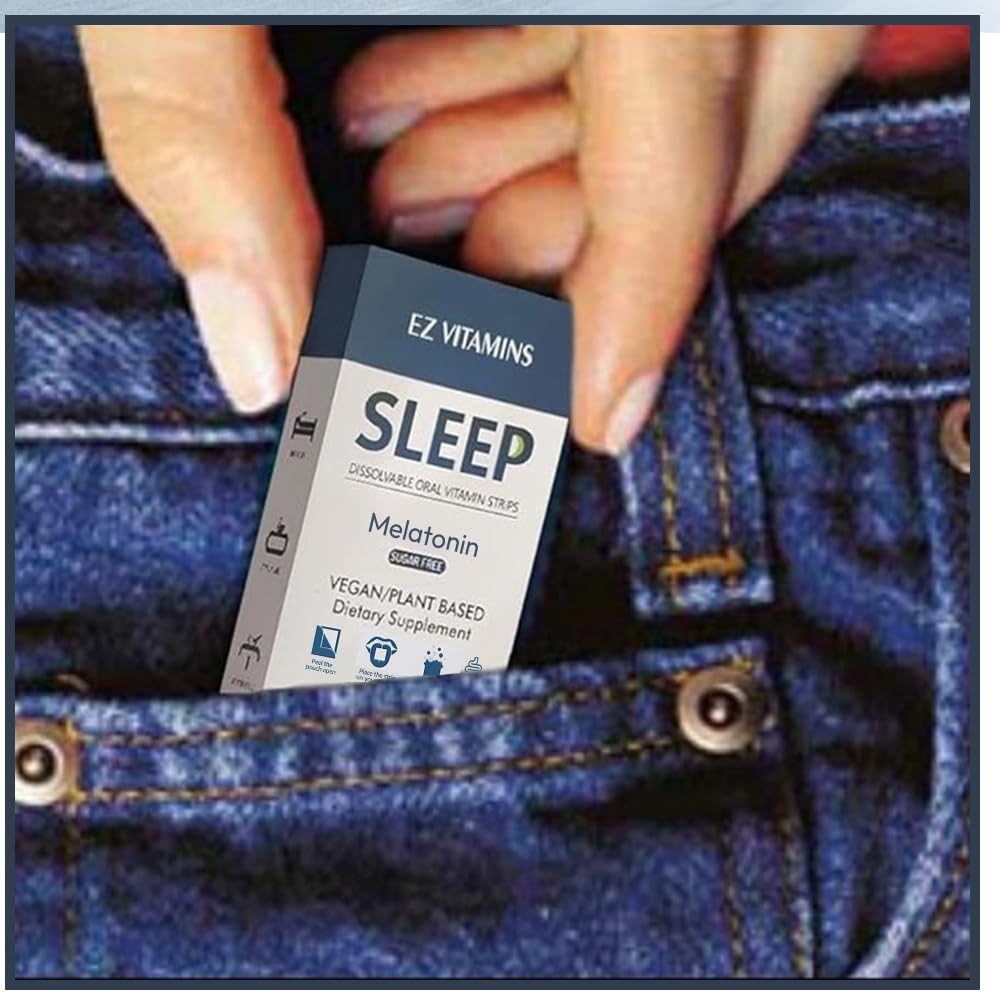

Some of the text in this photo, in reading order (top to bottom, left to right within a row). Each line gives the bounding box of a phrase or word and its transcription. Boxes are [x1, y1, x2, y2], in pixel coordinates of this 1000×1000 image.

[408, 312, 534, 367] EZ VITAMINS
[355, 391, 535, 482] SLEEP
[349, 463, 519, 514] DISSOLVABLE ORAL VITAMIN STRIPS
[368, 512, 479, 558] Melatonin
[389, 551, 443, 573] SUGAR FREE
[330, 575, 485, 622] VEGAN/PLANT BASED
[332, 599, 472, 641] Dietary Supplement
